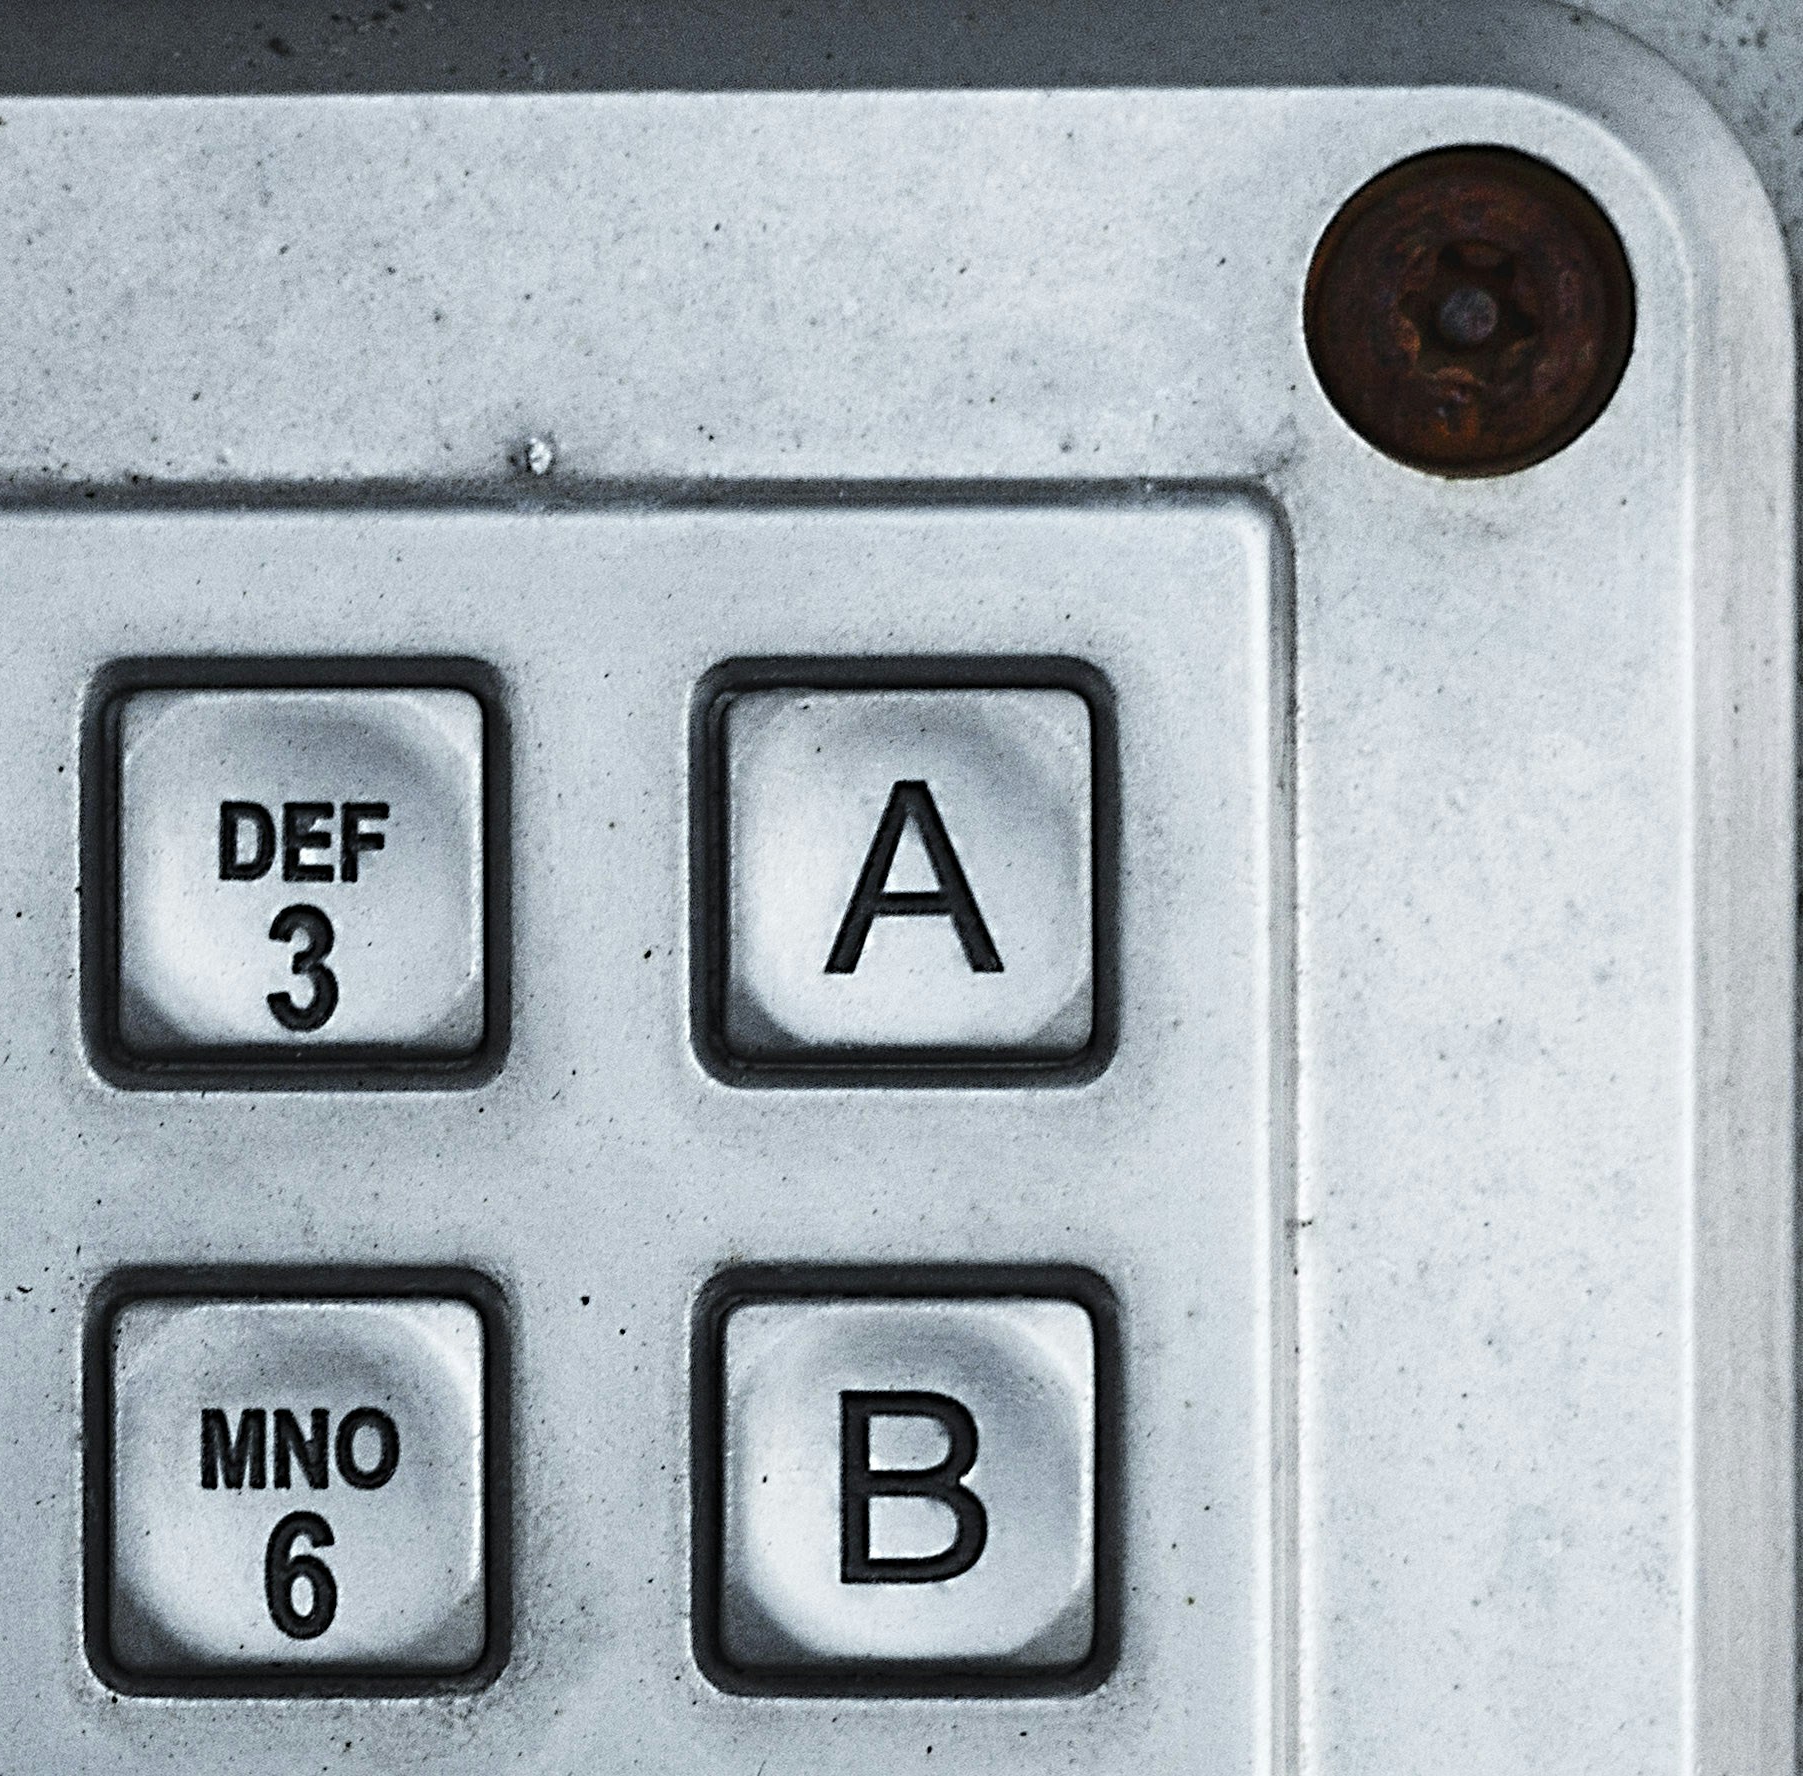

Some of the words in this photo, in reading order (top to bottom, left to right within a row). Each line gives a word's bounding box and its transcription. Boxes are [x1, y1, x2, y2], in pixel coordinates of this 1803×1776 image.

[219, 801, 387, 883] DEF
[825, 780, 1004, 973] A
[264, 904, 340, 1034] 3
[201, 1407, 400, 1490] MNO
[839, 1390, 988, 1584] B
[265, 1511, 337, 1640] 6
